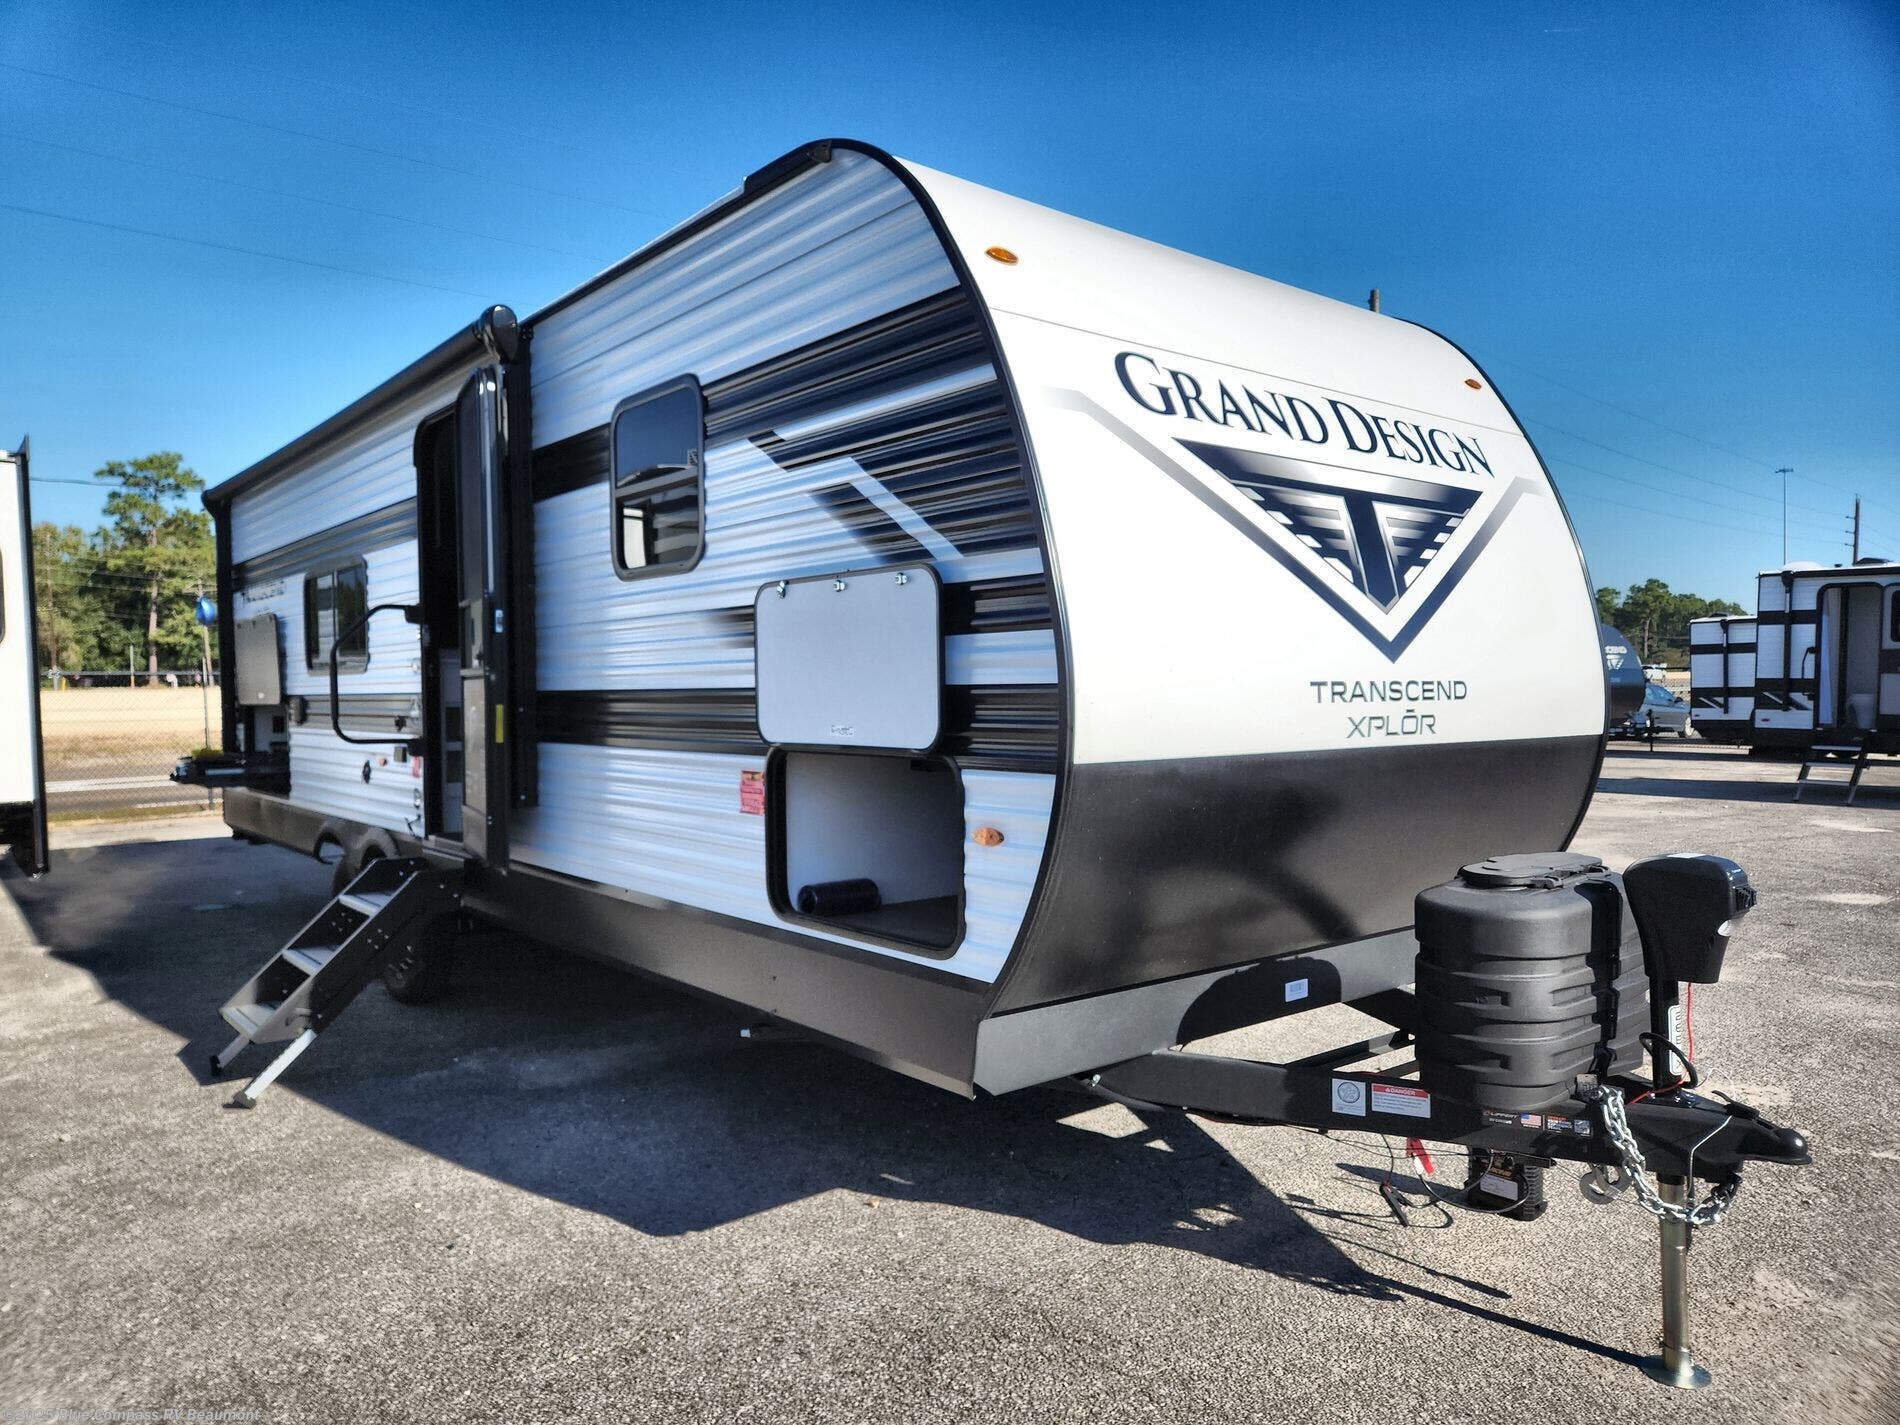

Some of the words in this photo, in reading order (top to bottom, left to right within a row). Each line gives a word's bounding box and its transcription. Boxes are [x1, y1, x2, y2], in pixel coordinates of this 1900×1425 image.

[1114, 351, 1329, 445] GRAND
[1321, 396, 1495, 477] DESIGN
[1310, 680, 1467, 703] TRANSCEND
